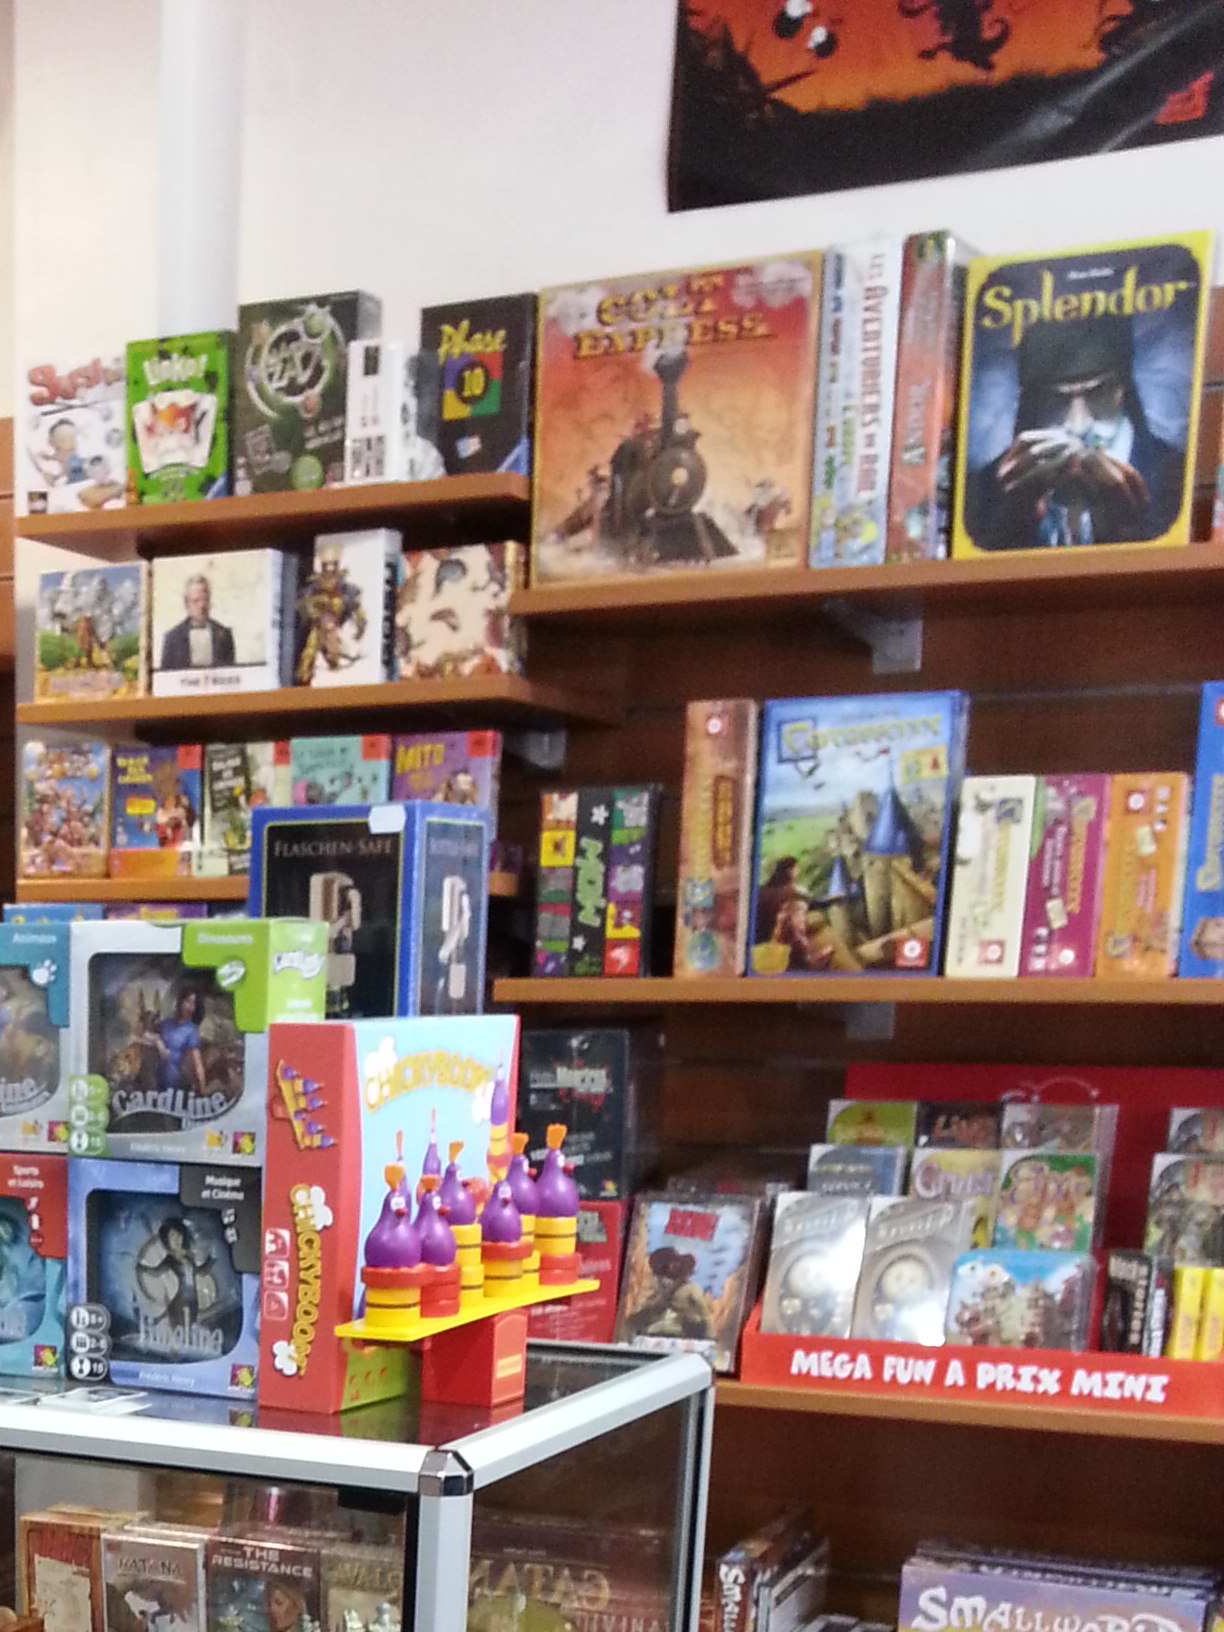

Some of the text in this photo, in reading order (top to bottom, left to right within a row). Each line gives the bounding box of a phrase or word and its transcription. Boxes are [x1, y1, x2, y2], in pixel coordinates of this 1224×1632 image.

[980, 265, 1188, 349] Splendor
[205, 1174, 242, 1187] Musique
[290, 1184, 323, 1378] CHICKYBOOM
[92, 1362, 104, 1373] 15
[790, 1348, 1171, 1403] MEGA FUN A PRIX MINI
[243, 1544, 280, 1562] THE
[117, 1554, 184, 1578] KATANA
[212, 1555, 314, 1578] RESISTANCE
